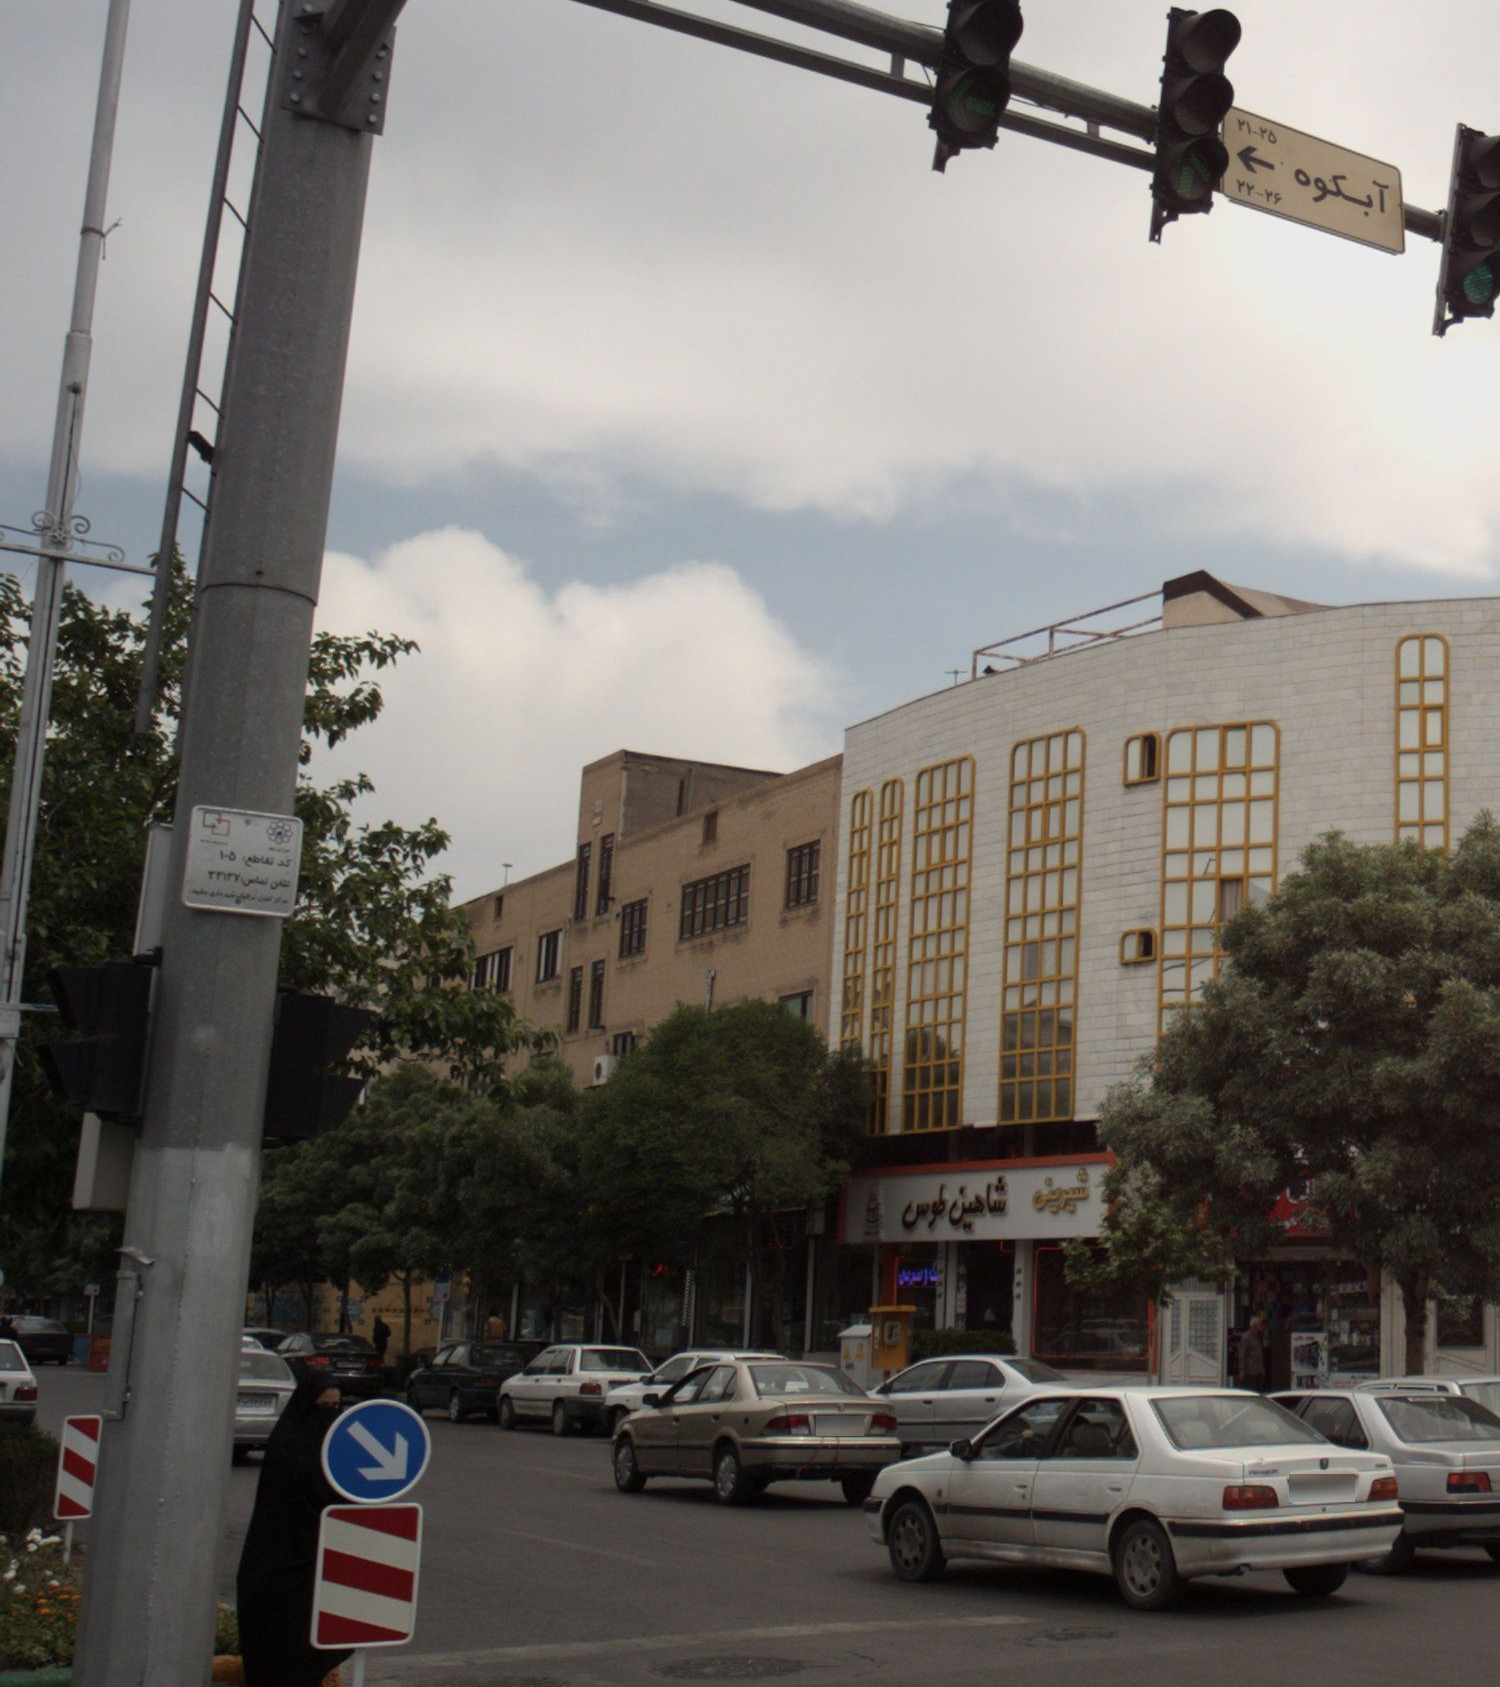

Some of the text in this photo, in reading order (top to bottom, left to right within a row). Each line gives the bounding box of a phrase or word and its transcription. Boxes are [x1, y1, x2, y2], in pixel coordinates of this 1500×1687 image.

[1236, 118, 1278, 145] ۲۱-۲۵
[1235, 179, 1283, 204] ۲۲-۲۶
[1294, 168, 1390, 217] آبکوه
[901, 1175, 1008, 1231] شاهین طوس
[1032, 1166, 1091, 1214] شیرینی
